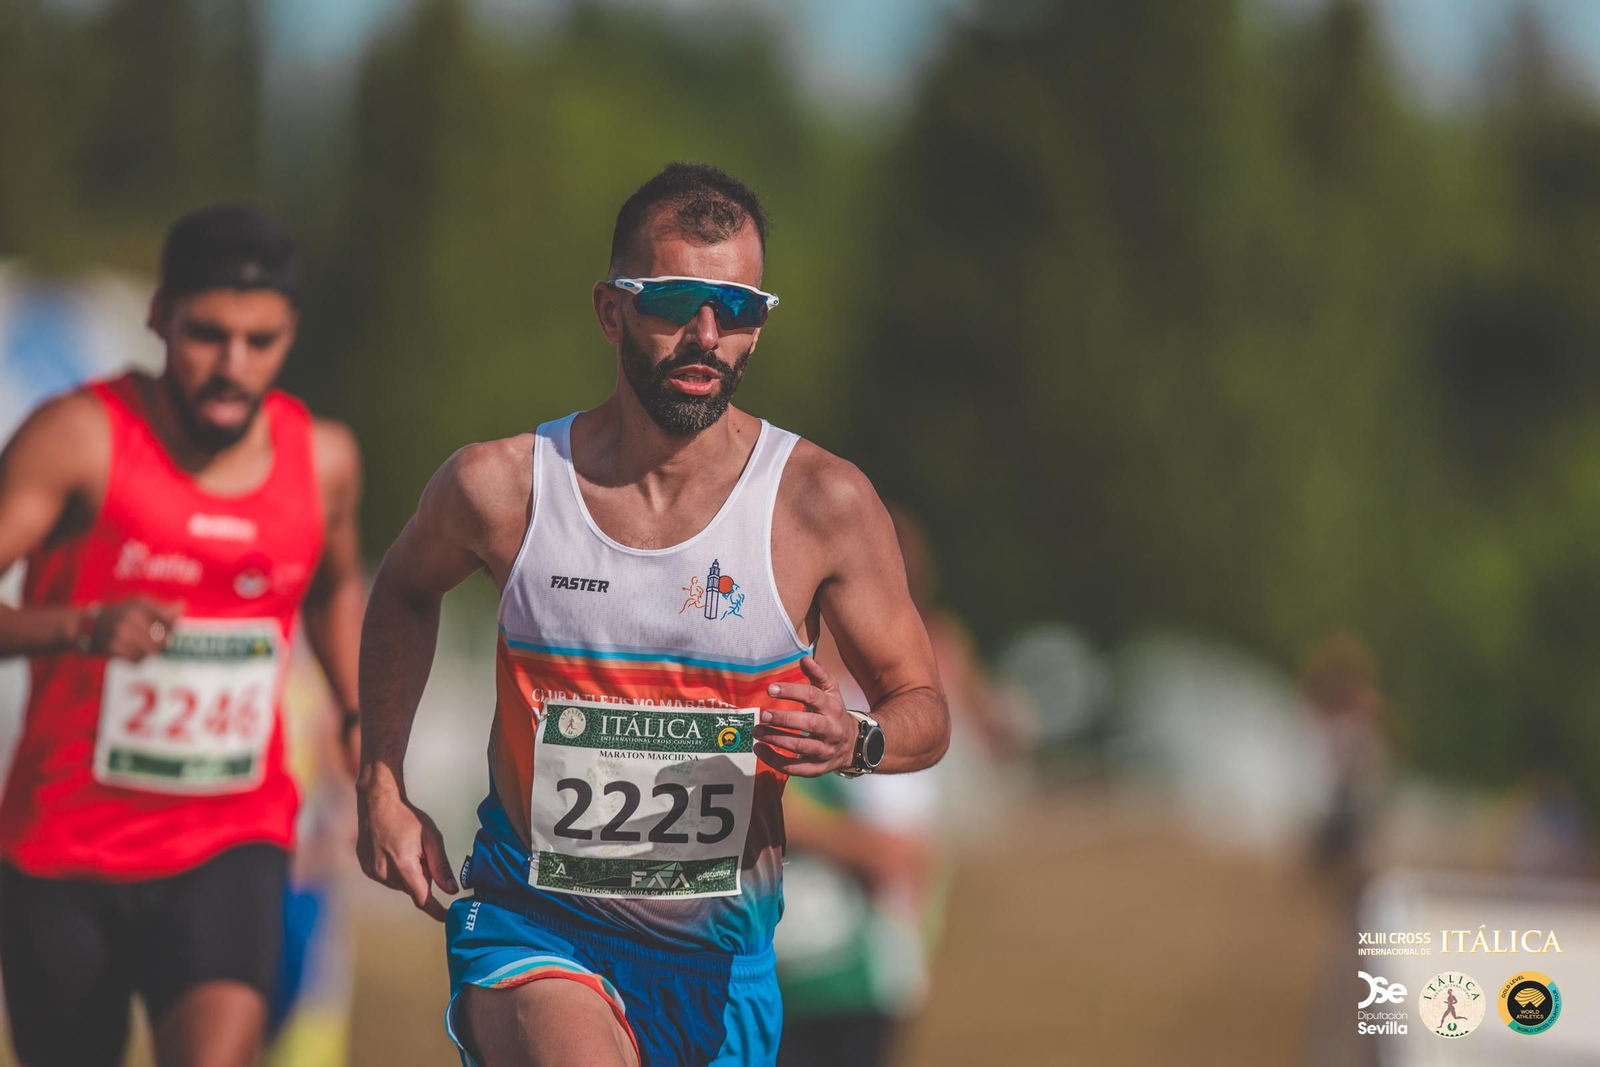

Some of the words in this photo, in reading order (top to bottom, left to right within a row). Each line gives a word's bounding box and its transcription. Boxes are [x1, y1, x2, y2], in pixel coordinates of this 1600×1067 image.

[550, 575, 610, 593] FASTER
[601, 712, 702, 739] ITÁLICA
[600, 736, 650, 744] INTERNATIONAL
[599, 750, 645, 760] MARATON
[647, 753, 699, 762] MARCHENA
[554, 778, 735, 844] 2225
